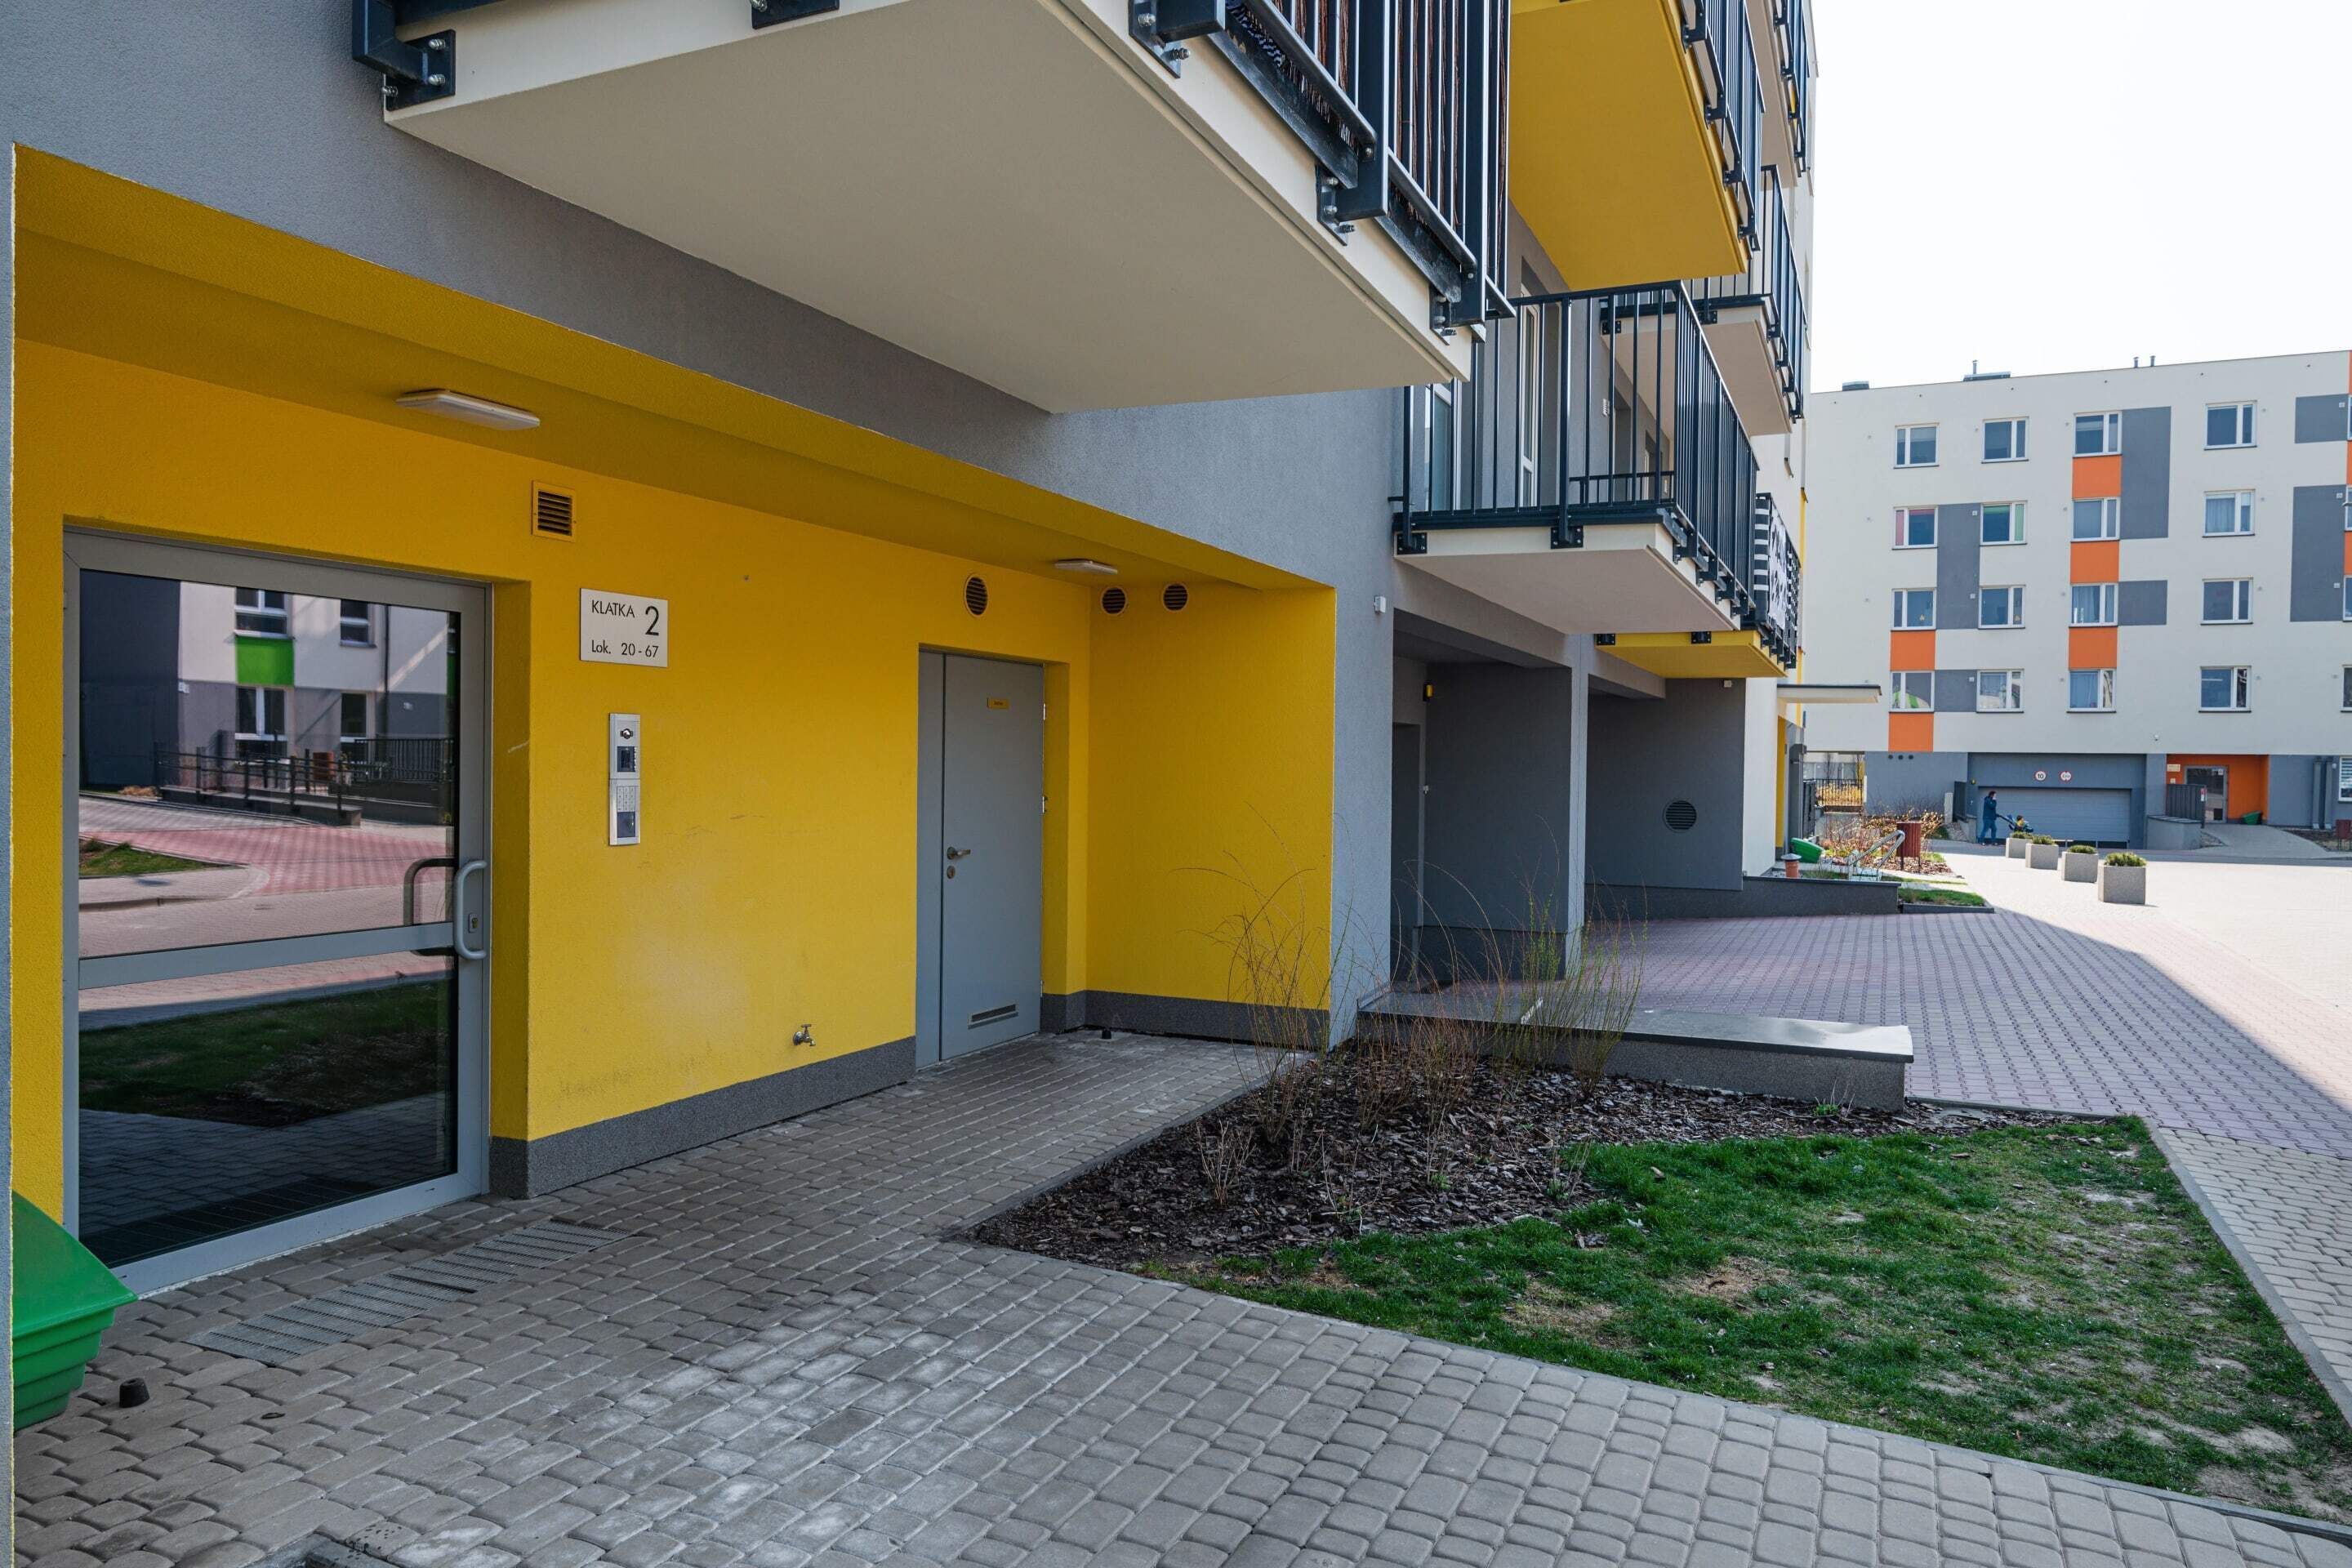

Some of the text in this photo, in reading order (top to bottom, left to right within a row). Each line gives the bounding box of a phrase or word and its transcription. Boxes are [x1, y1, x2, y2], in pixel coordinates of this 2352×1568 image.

[592, 599, 659, 636] KLATKA 2
[592, 639, 611, 654] Lok.
[621, 643, 635, 656] 20
[645, 645, 658, 657] 67
